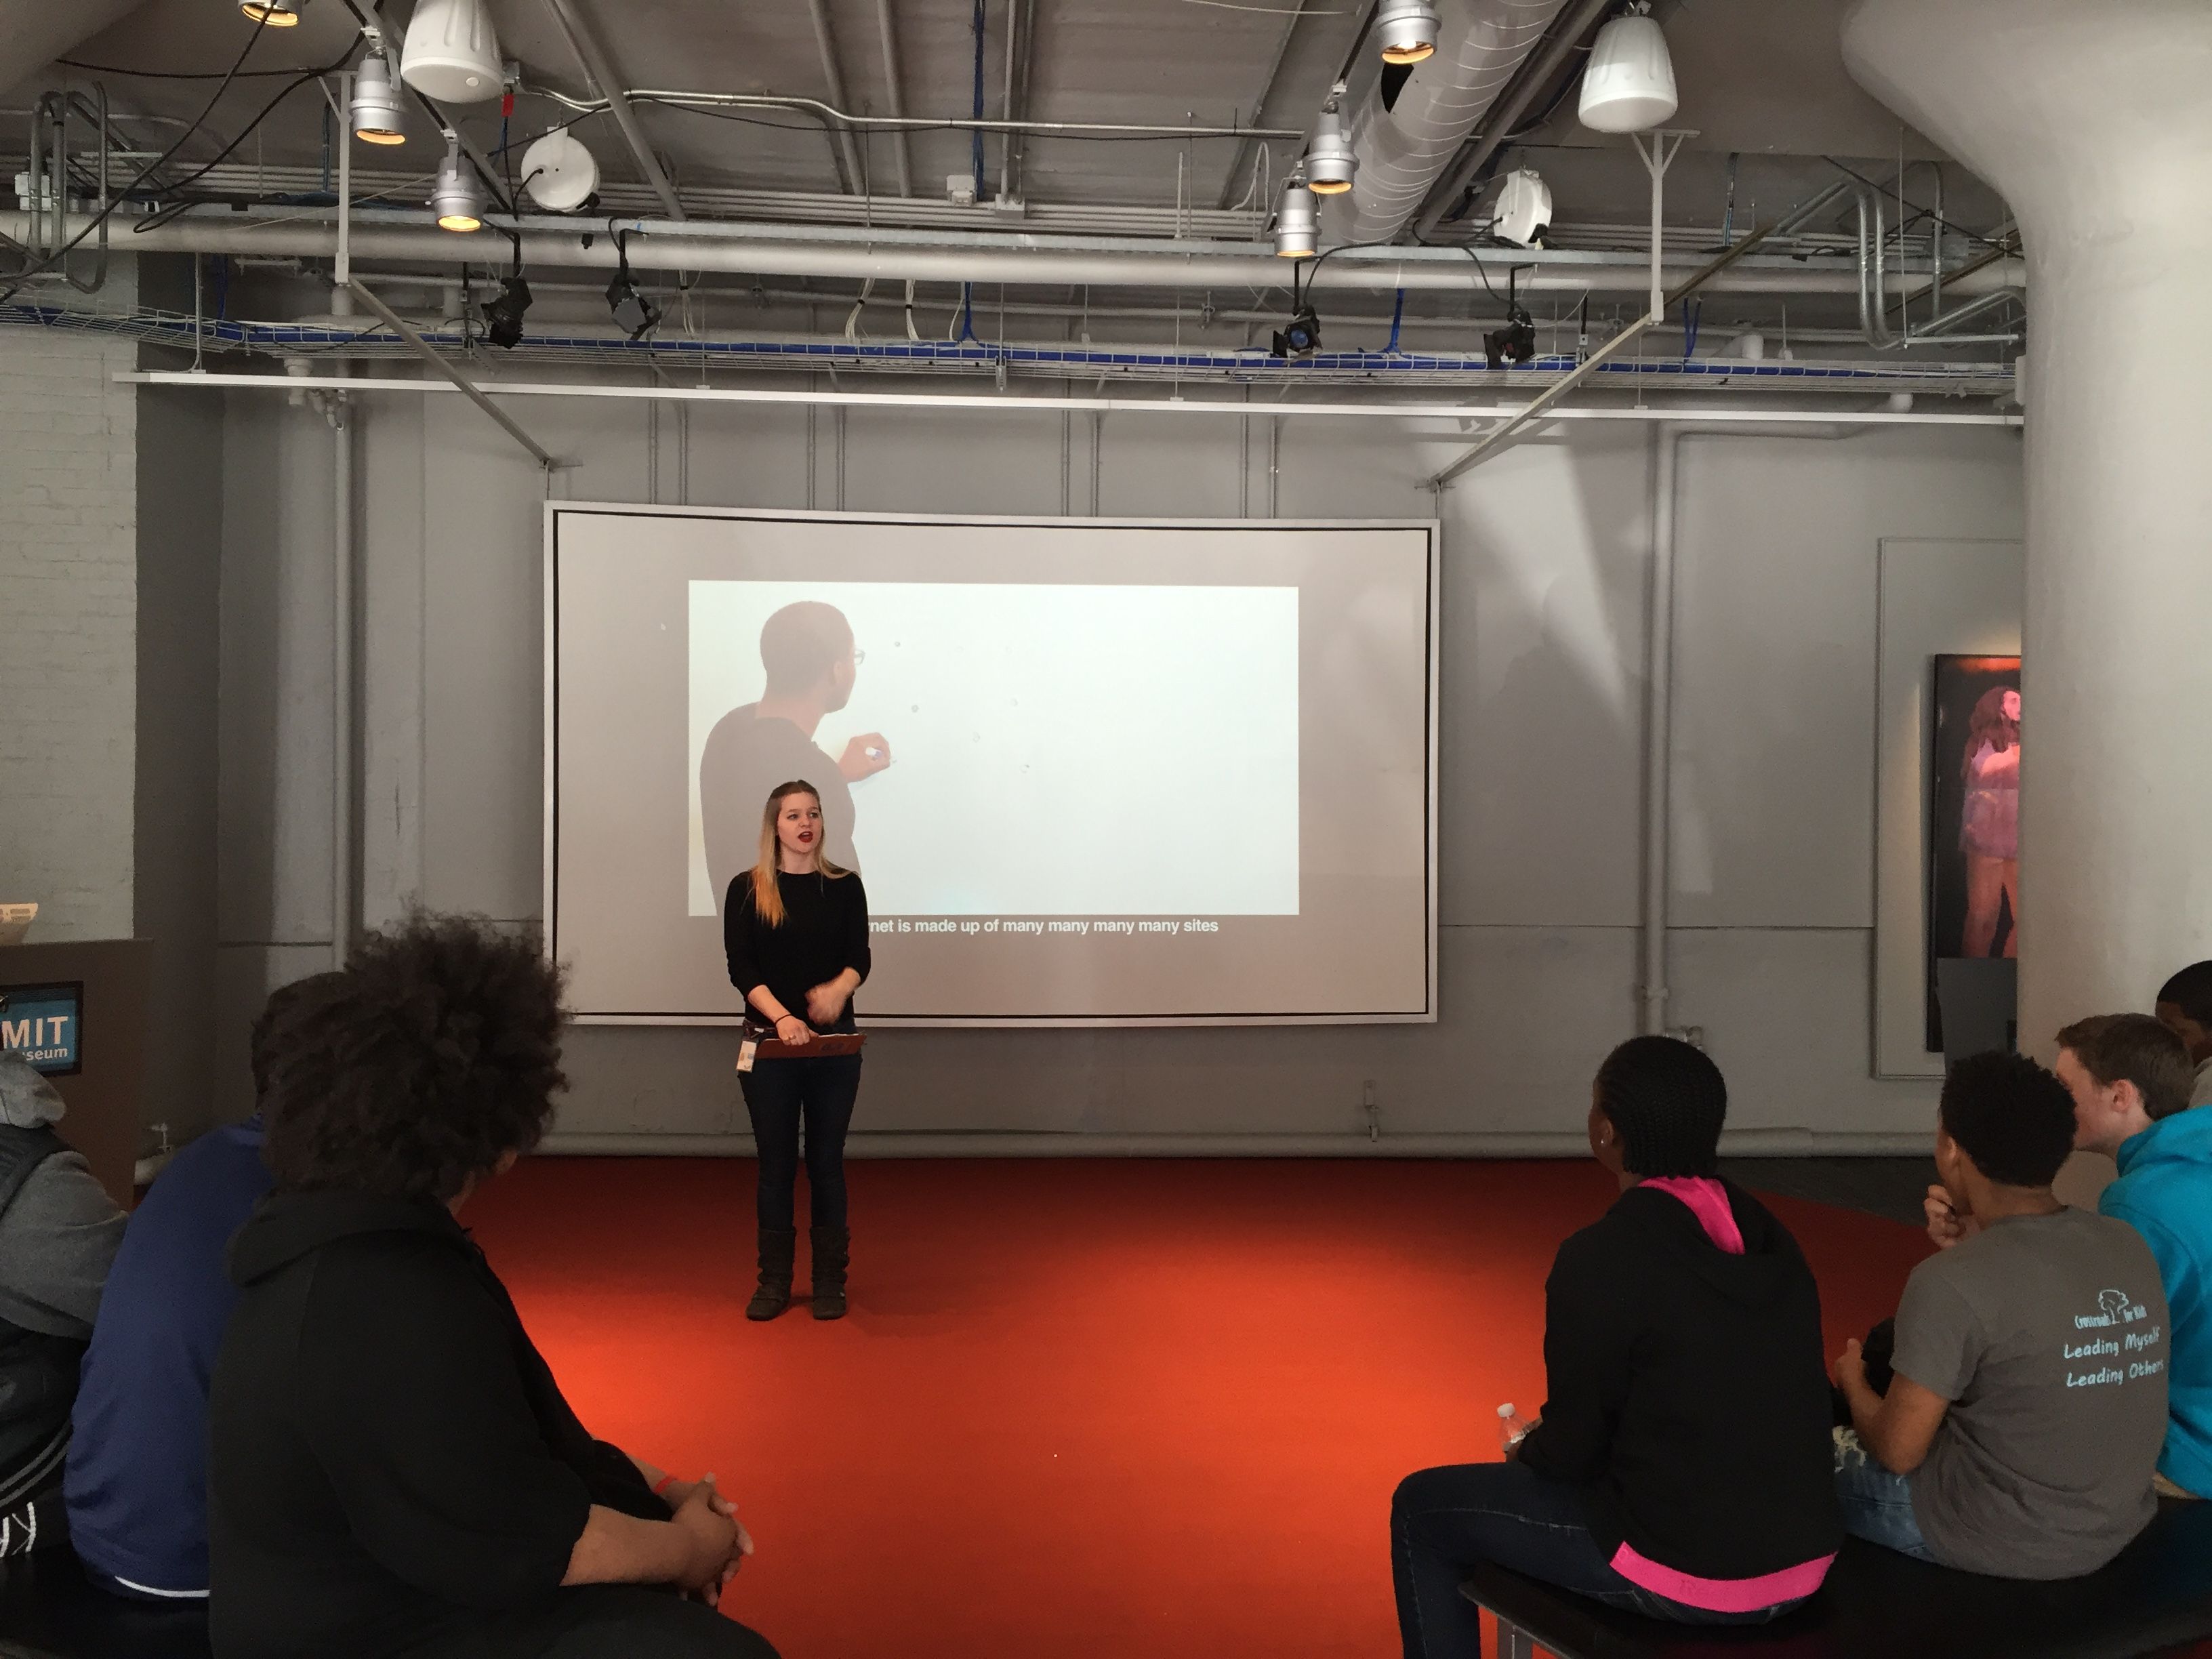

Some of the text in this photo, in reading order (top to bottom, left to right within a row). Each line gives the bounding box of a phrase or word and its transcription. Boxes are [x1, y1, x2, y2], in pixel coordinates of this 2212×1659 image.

[868, 918, 1219, 935] net is made up of many many many many sites
[1, 1016, 68, 1049] MIT
[22, 1048, 68, 1061] seum
[2064, 1326, 2160, 1359] Leading Myself
[2067, 1366, 2124, 1387] Leading
